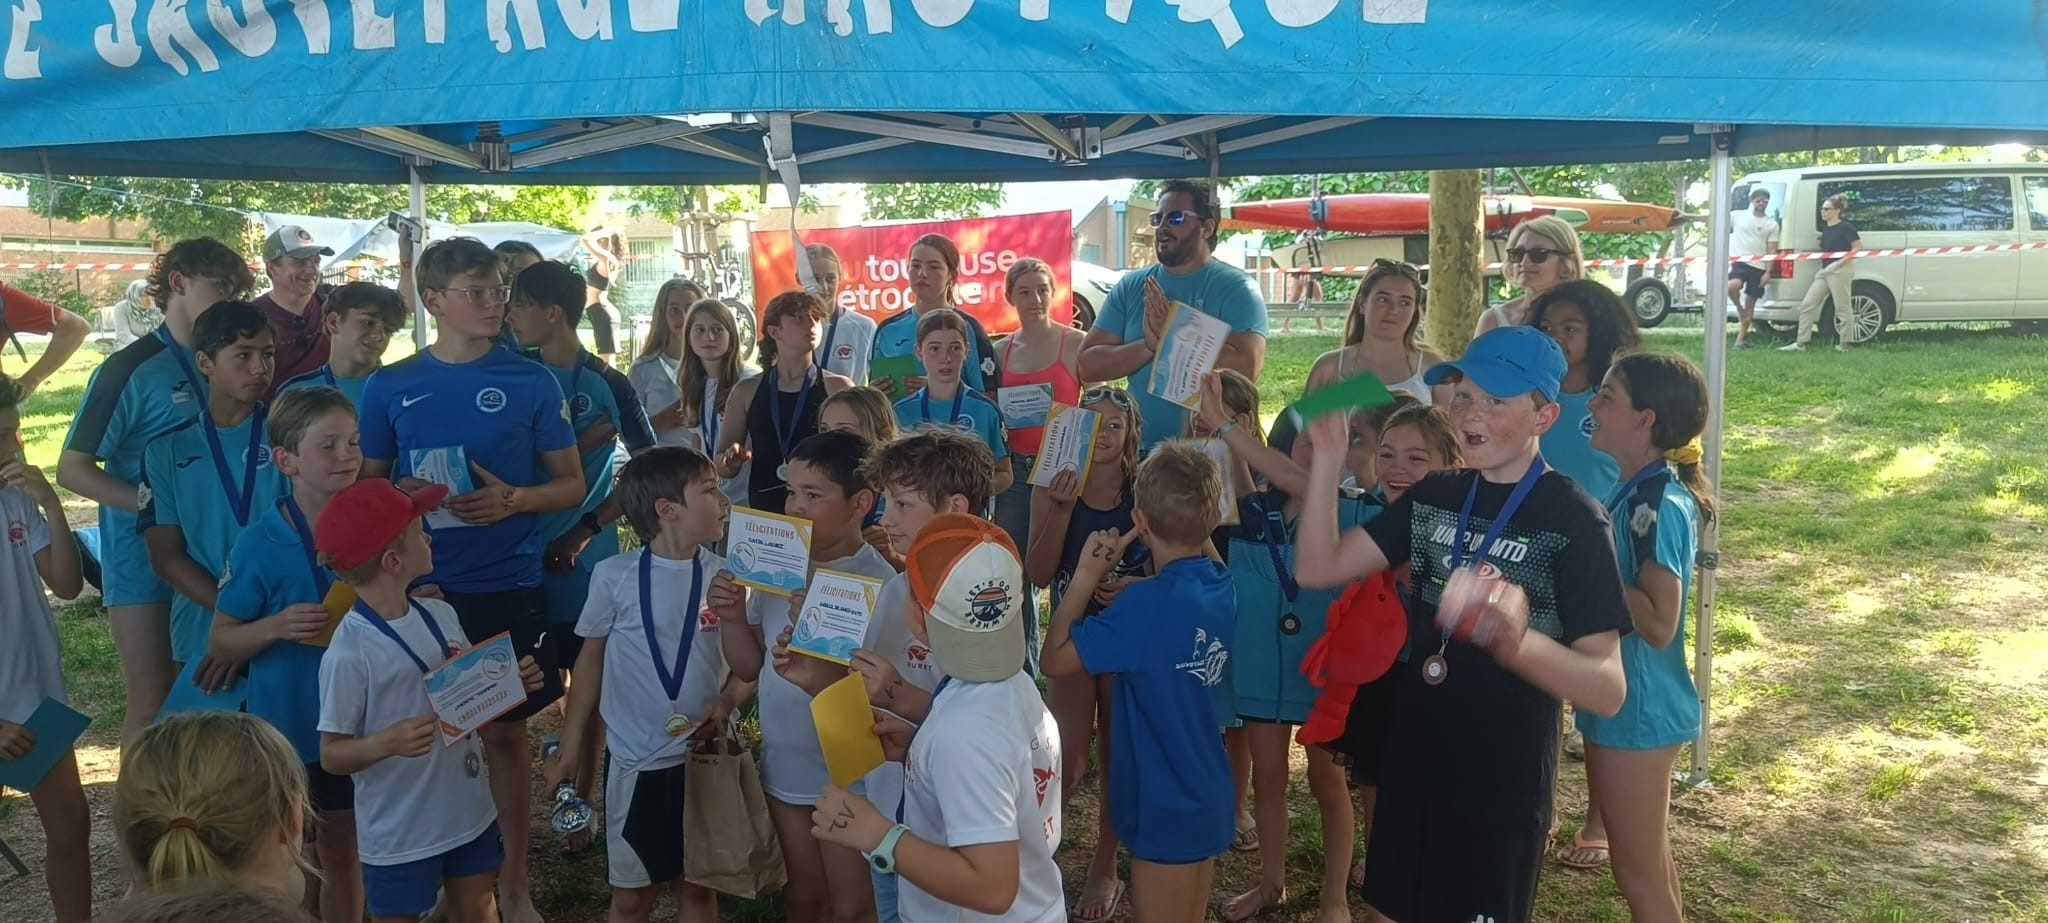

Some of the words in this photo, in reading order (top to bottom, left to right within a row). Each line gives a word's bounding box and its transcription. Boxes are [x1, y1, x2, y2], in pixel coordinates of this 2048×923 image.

[866, 249, 1018, 282] touse
[745, 521, 795, 540] FÉLICITATIONS
[965, 580, 994, 602] LET'S
[998, 580, 1011, 592] GO
